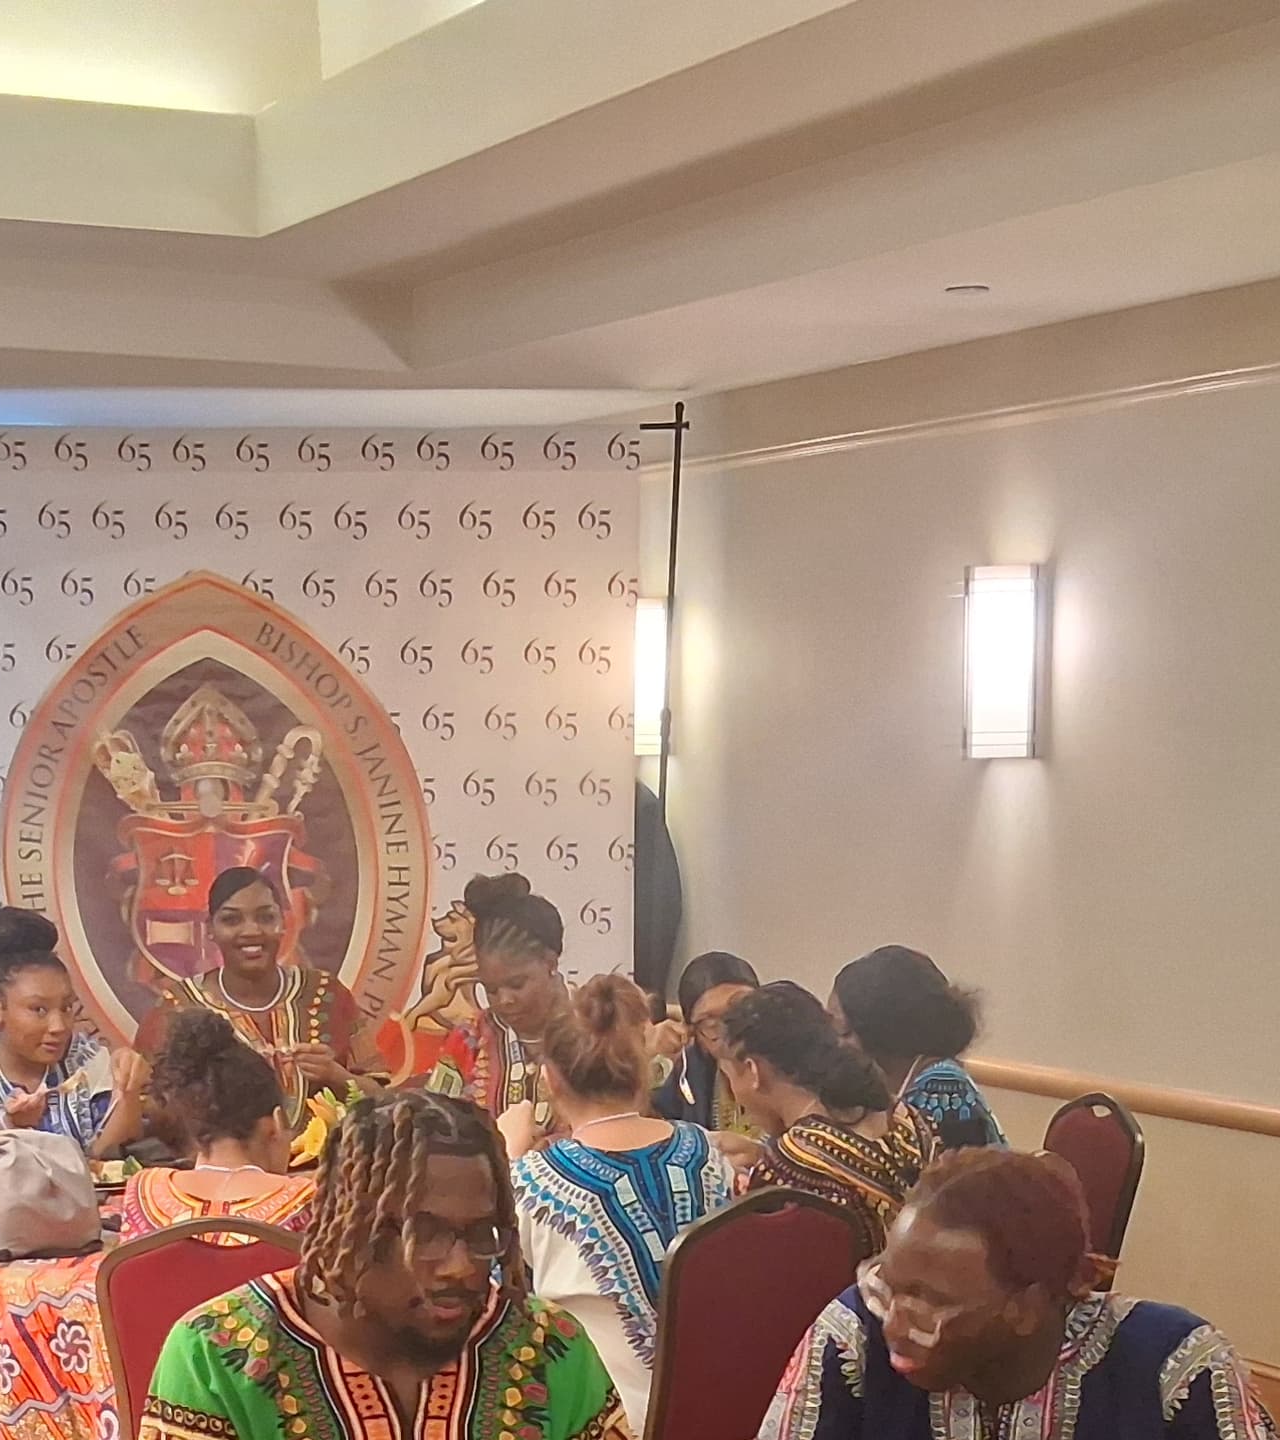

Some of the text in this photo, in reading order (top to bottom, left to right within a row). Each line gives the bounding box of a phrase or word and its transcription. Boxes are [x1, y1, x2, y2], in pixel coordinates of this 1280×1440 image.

[54, 433, 88, 471] 65
[118, 434, 151, 472] 65
[172, 433, 206, 472] 65
[236, 434, 270, 472] 65
[298, 433, 331, 472] 65
[361, 433, 394, 471] 65
[417, 431, 450, 470] 65
[481, 432, 514, 470] 65
[543, 431, 576, 470] 65
[607, 431, 640, 470] 65
[38, 502, 71, 539] 65
[92, 502, 125, 539] 65
[155, 502, 188, 540] 65
[215, 503, 249, 540] 65
[279, 502, 312, 540] 65
[334, 502, 367, 540] 65
[398, 502, 430, 539] 65
[459, 502, 492, 540] 65
[522, 502, 556, 539] 65
[578, 502, 611, 539] 65
[1, 569, 33, 605] 65
[61, 570, 94, 606] 65
[302, 570, 335, 607] 65
[365, 571, 398, 607] 65
[419, 570, 452, 607] 65
[483, 571, 515, 607] 65
[544, 571, 577, 607] 65
[607, 570, 637, 607] 65
[400, 637, 433, 674] 65
[461, 638, 493, 674] 65
[524, 638, 556, 674] 65
[578, 638, 611, 674] 65
[255, 621, 352, 708] BISHOP
[354, 743, 409, 855] JANINE
[422, 705, 454, 741] 65
[484, 704, 517, 740] 65
[545, 706, 577, 741] 65
[18, 624, 144, 913] HE SENIOR APOSTLE
[463, 771, 495, 806] 65
[525, 771, 557, 806] 65
[579, 771, 611, 806] 65
[486, 834, 518, 871] 65
[546, 836, 578, 871] 65
[580, 900, 612, 934] 65
